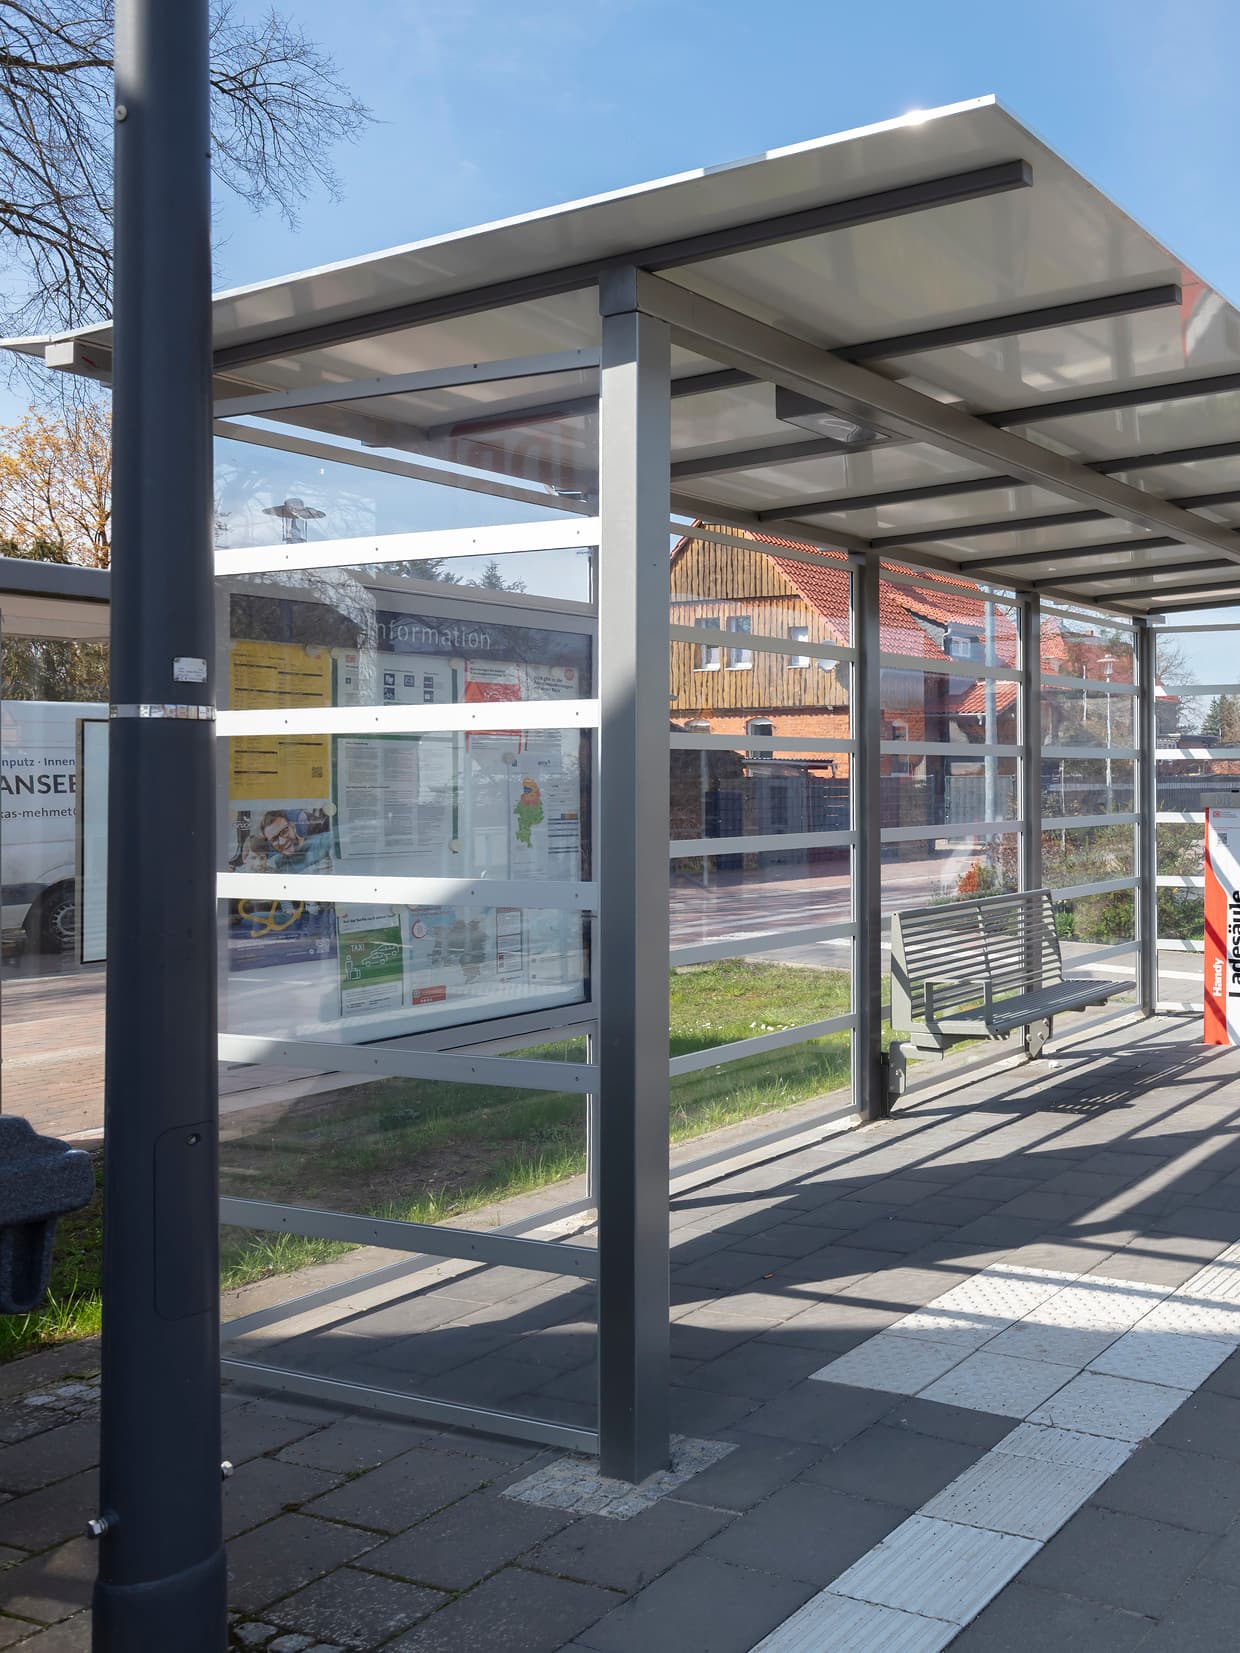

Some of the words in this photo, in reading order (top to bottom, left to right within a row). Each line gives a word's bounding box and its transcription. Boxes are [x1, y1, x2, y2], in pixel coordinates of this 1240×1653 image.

[369, 620, 490, 649] nformation
[44, 757, 75, 766] Innen
[351, 943, 365, 953] TAXI
[1212, 957, 1225, 997] Handy
